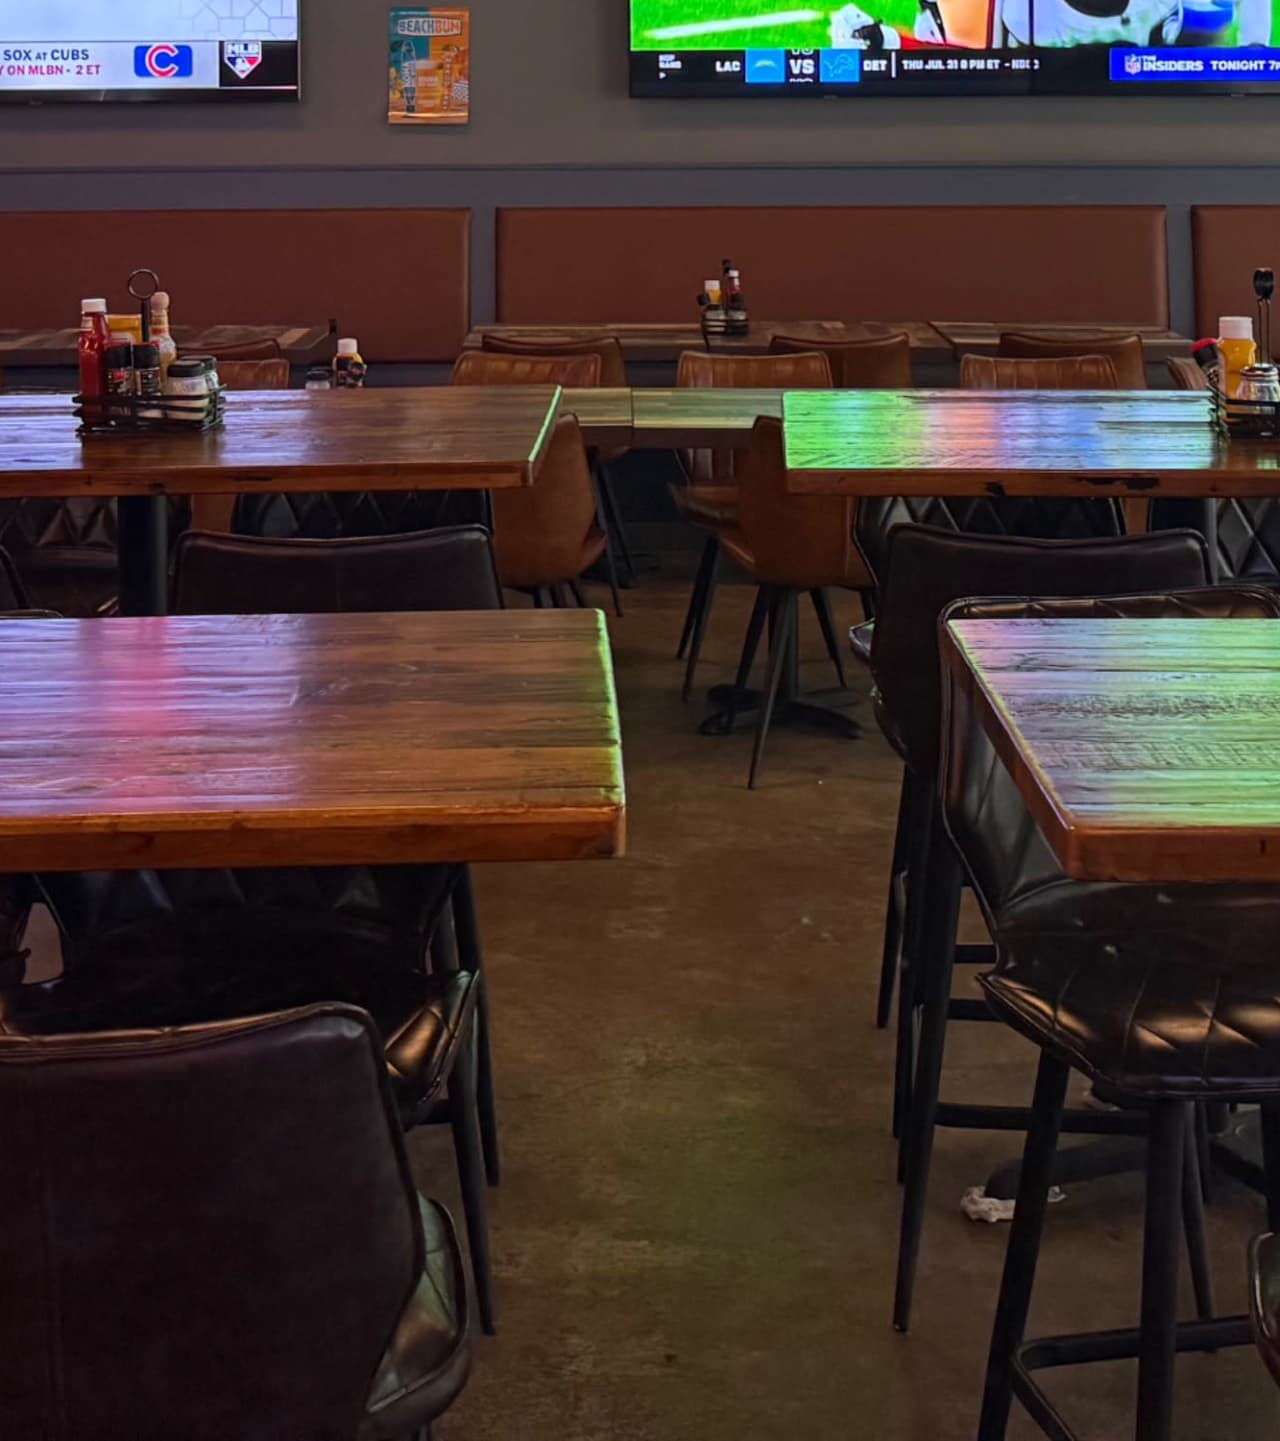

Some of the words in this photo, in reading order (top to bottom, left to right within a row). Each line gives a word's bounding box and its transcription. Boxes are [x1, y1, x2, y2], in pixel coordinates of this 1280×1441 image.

[3, 49, 32, 61] SOX
[35, 52, 48, 60] AT
[51, 48, 89, 61] CUBS
[7, 65, 25, 76] ON
[27, 64, 64, 76] MLBN
[76, 64, 83, 75] 2
[86, 64, 101, 75] ET
[789, 59, 814, 74] VS
[1210, 60, 1266, 71] TONIGHT
